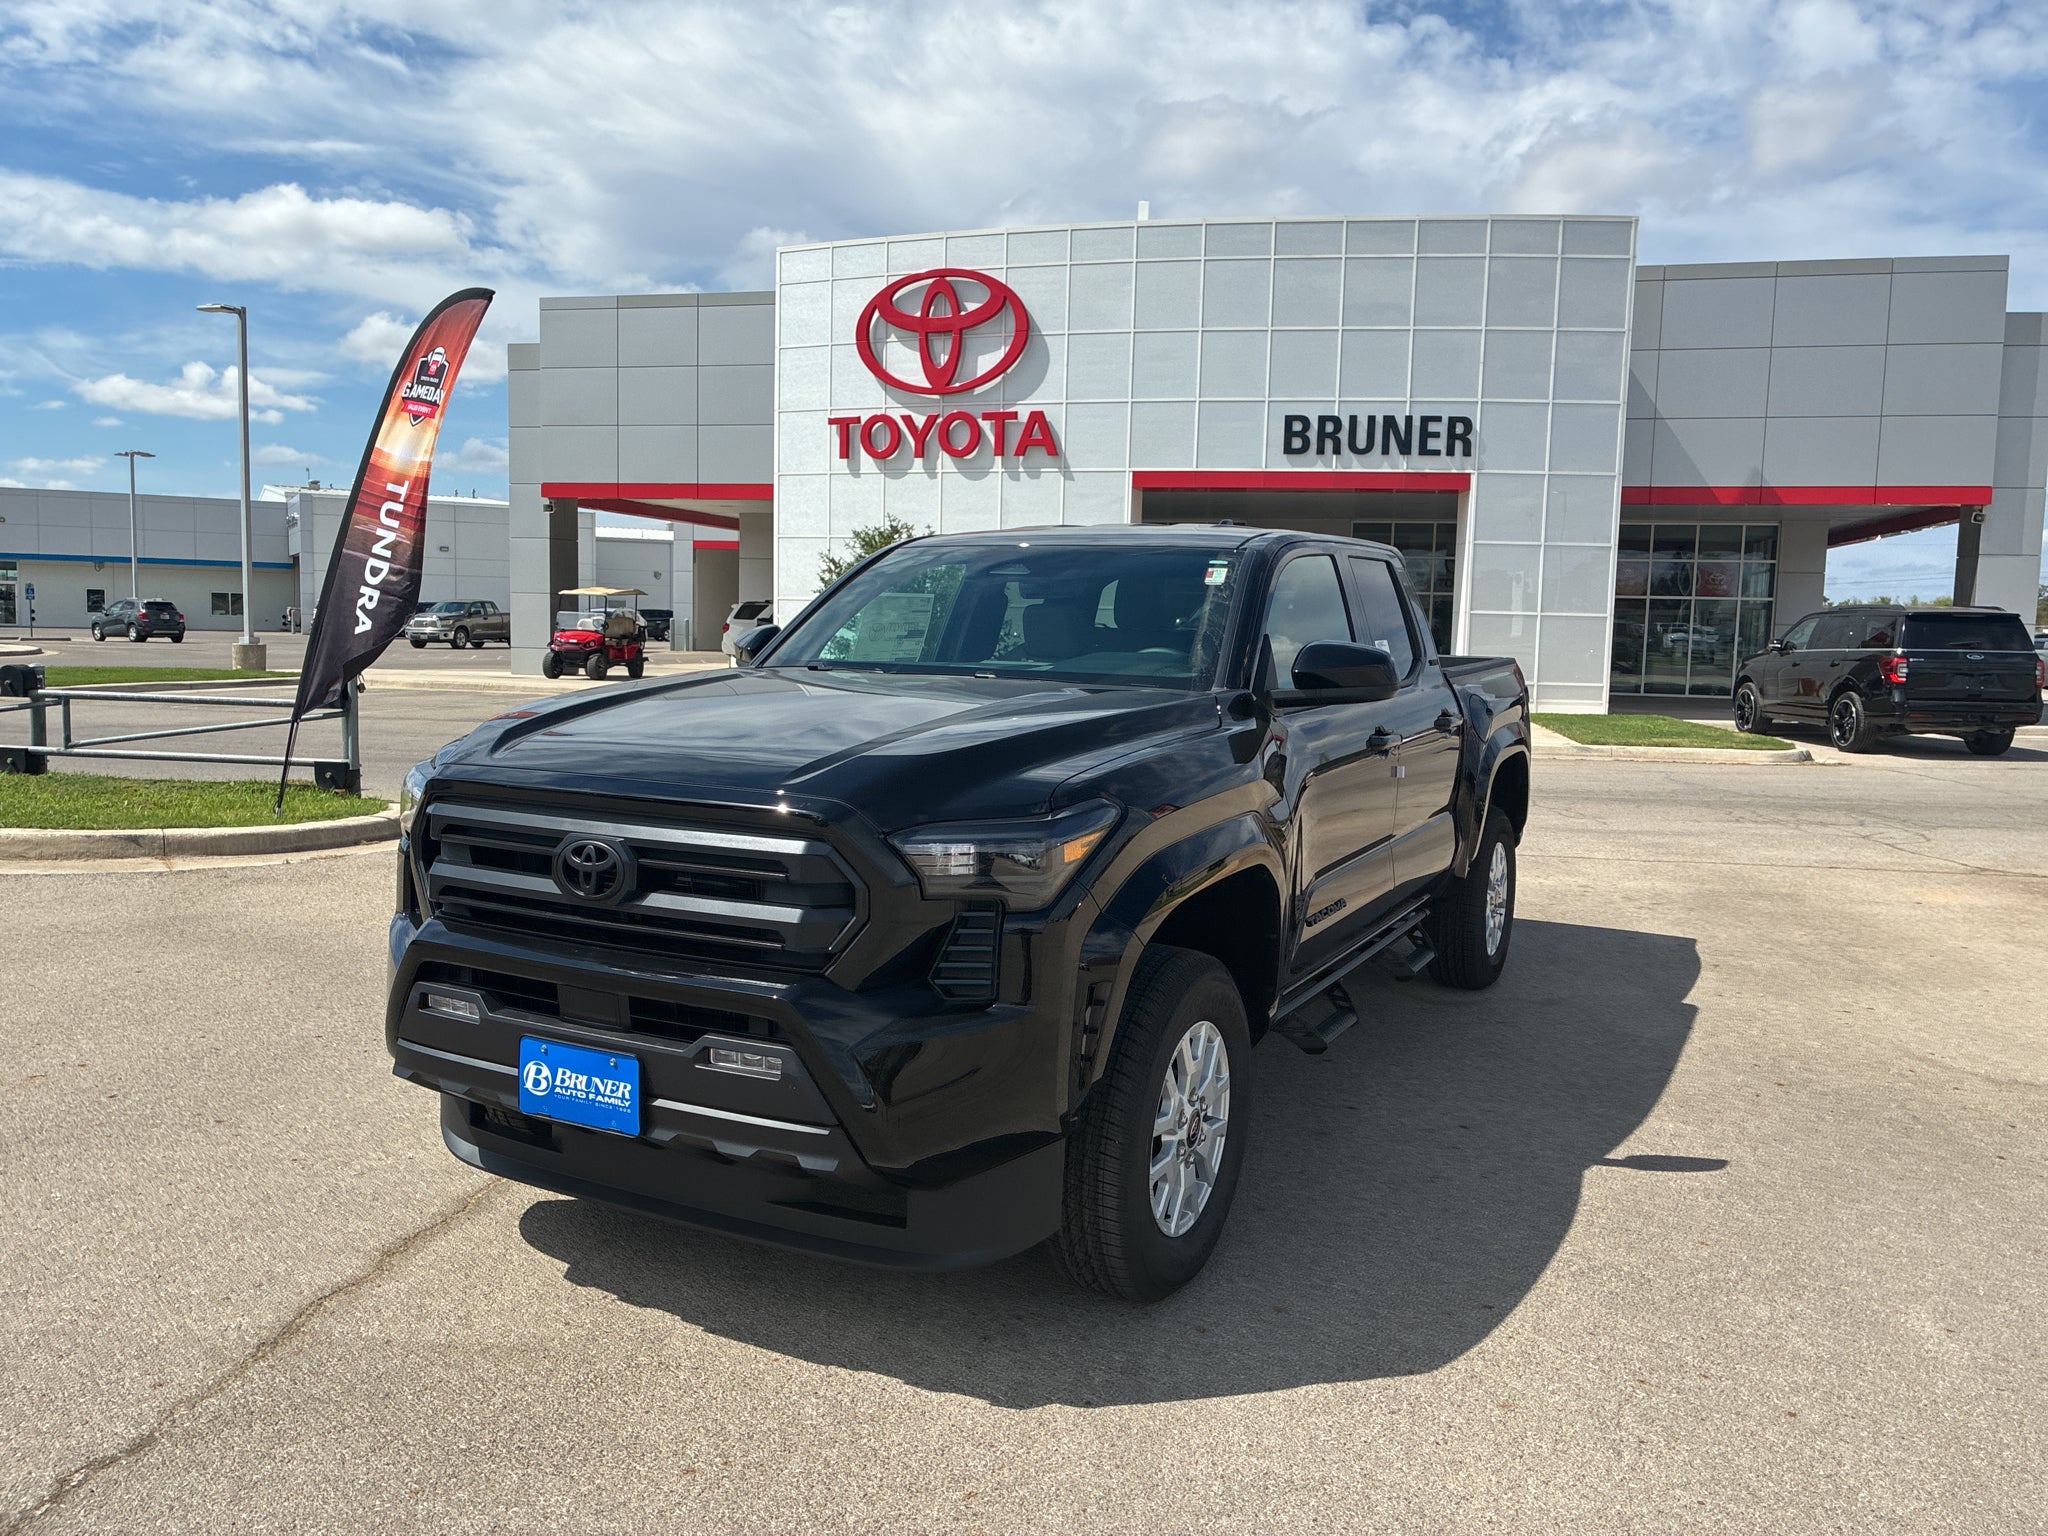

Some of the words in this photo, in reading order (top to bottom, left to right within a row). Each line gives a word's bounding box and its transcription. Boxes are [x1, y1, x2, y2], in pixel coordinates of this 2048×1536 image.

[402, 381, 445, 404] GAMEDAY
[828, 410, 1059, 460] TOYOTA
[1283, 415, 1474, 457] BRUNER
[354, 480, 409, 634] TUNDRA
[554, 1067, 632, 1099] BRUNER
[554, 1086, 586, 1099] AUTO
[588, 1093, 632, 1107] FAMILY
[571, 1097, 592, 1105] FAMILY
